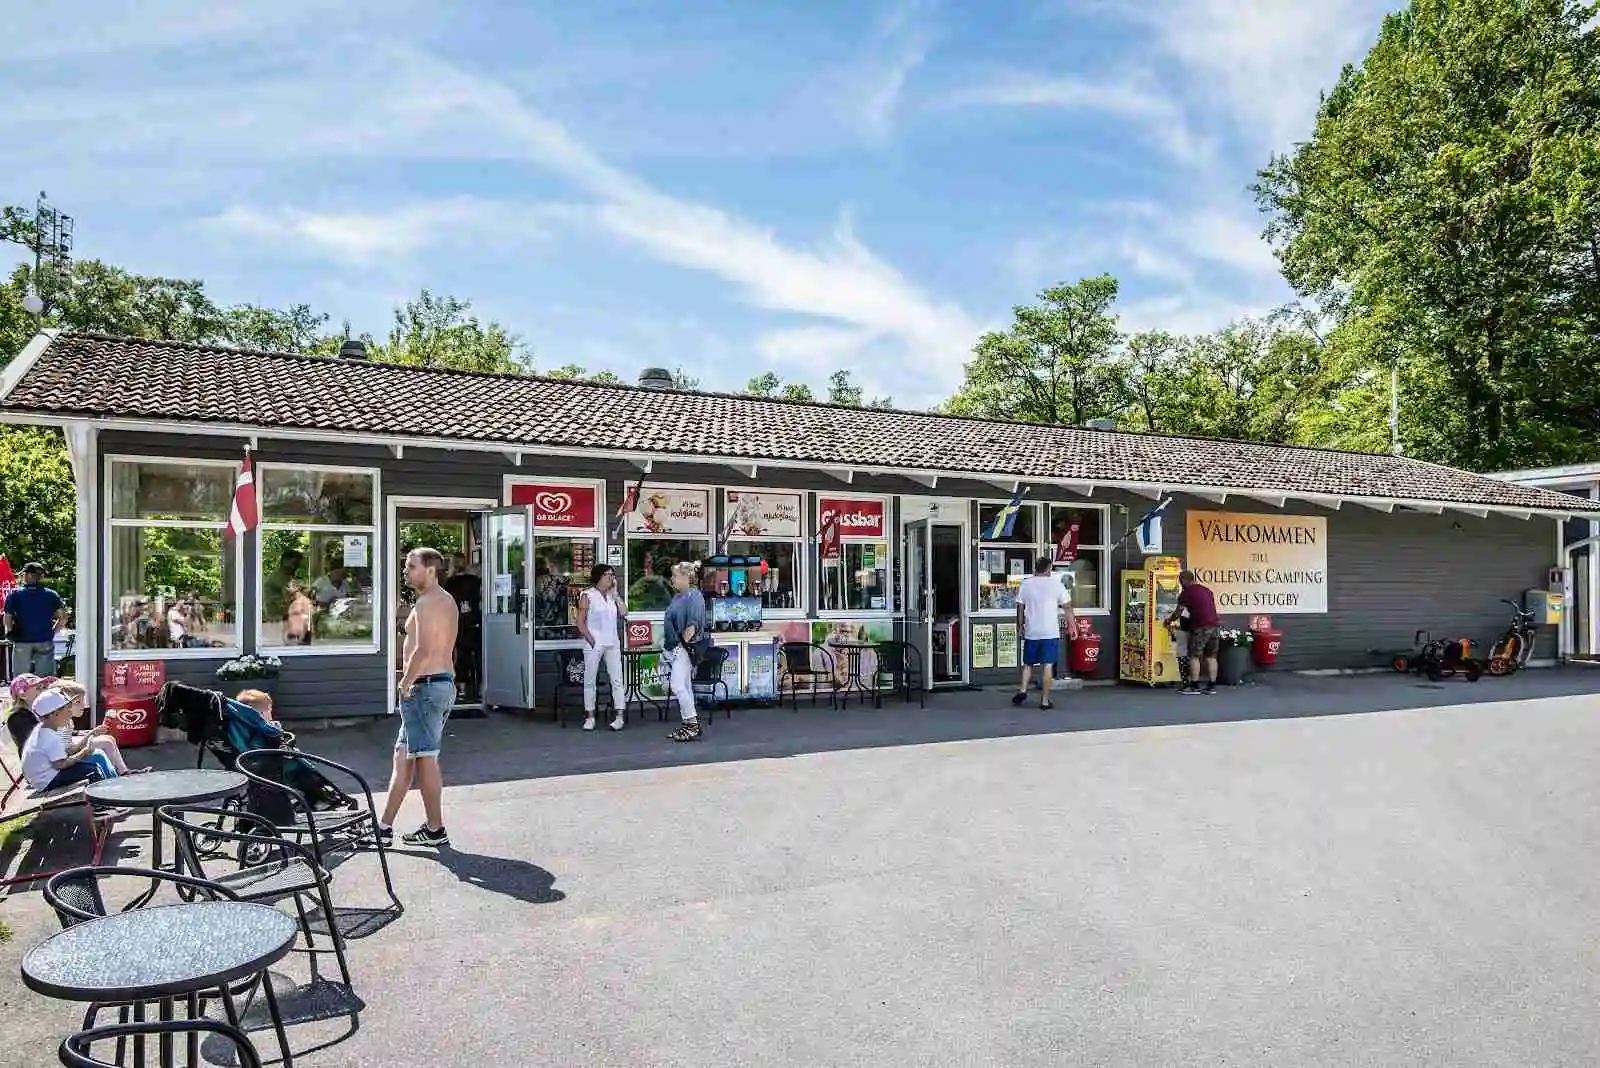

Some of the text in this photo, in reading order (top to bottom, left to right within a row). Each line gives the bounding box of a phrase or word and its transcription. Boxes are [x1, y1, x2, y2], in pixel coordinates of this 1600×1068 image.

[1198, 519, 1316, 544] VÄLKOMMEN
[1193, 567, 1323, 584] KOLLEVIKS CAMPING
[1219, 591, 1299, 606] OCH STUGBY
